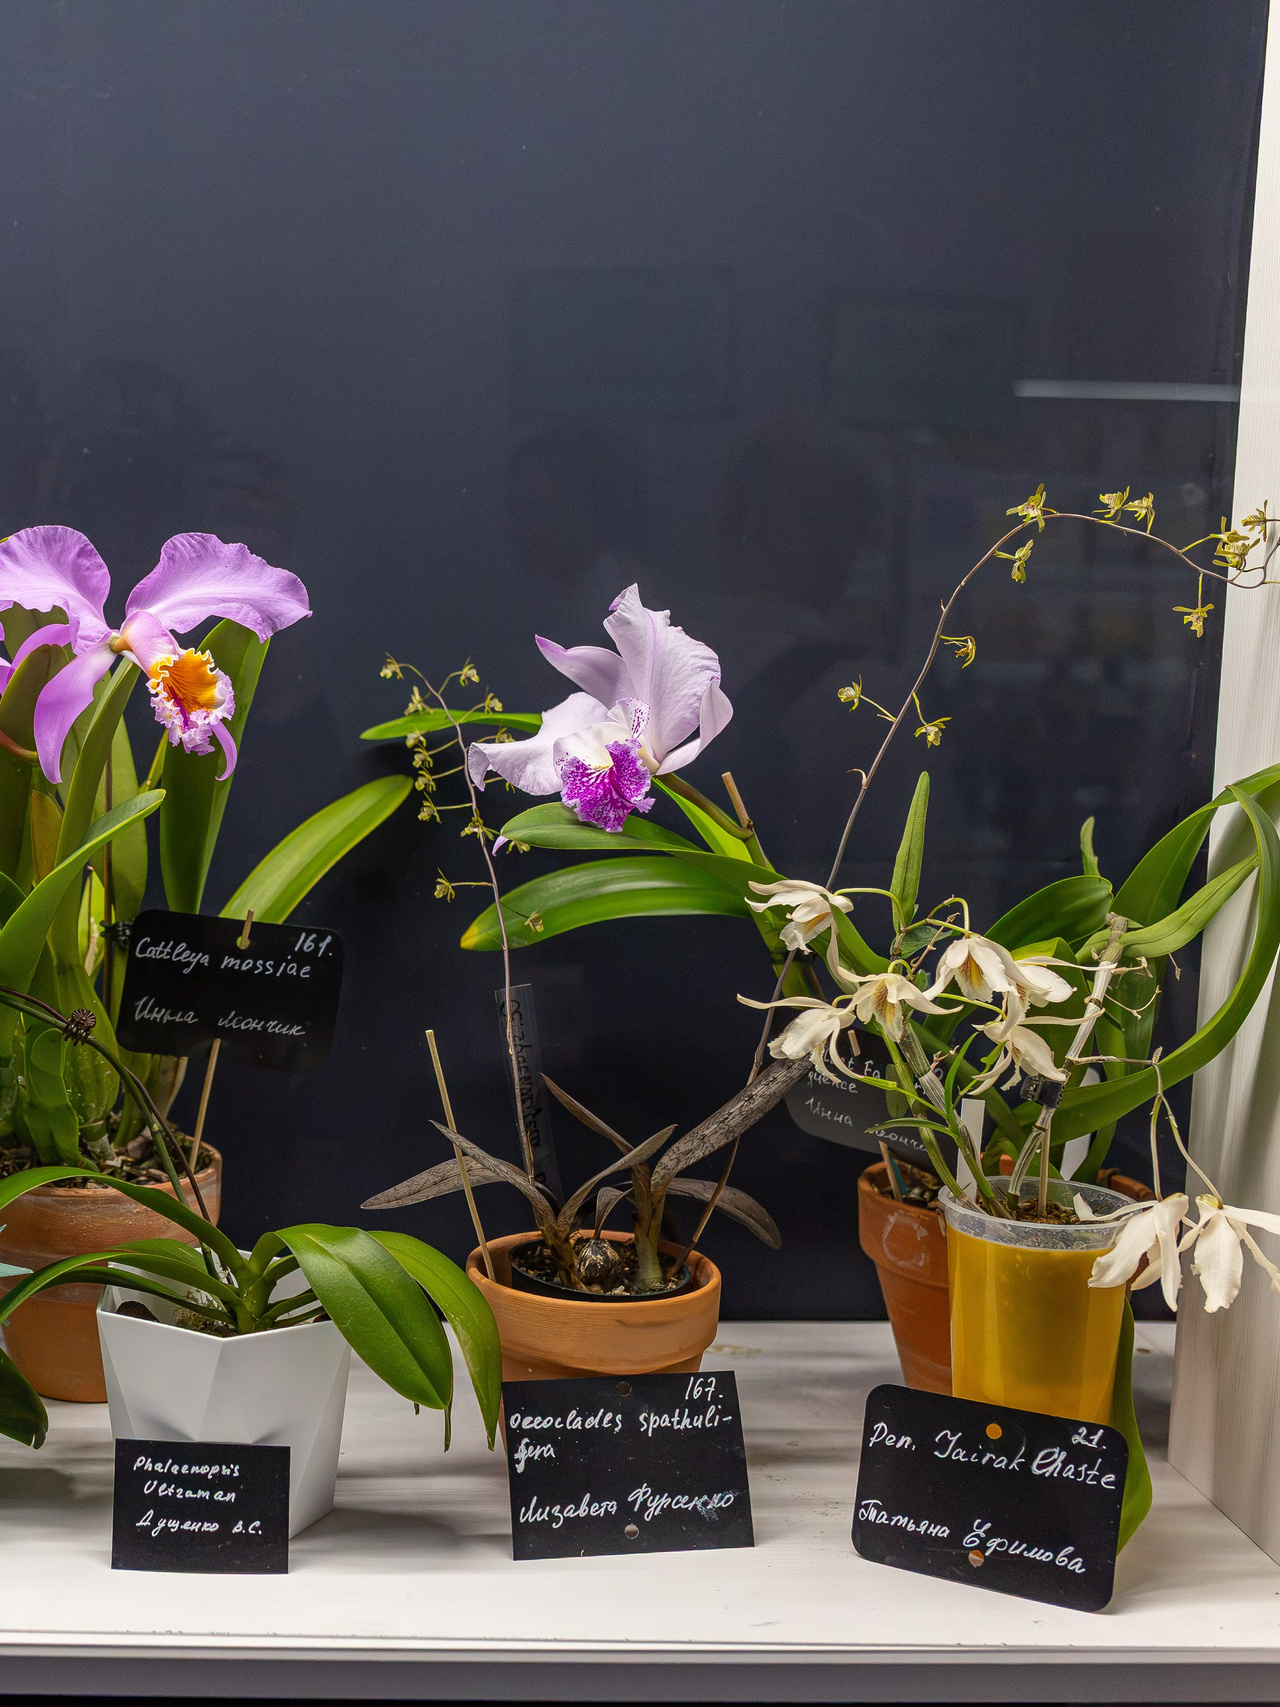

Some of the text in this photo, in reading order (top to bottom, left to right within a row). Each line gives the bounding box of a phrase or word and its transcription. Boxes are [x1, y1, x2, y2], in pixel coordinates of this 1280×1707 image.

[135, 937, 312, 978] Cattleya mossiae
[858, 1499, 1086, 1574] Татьяна Ефимова
